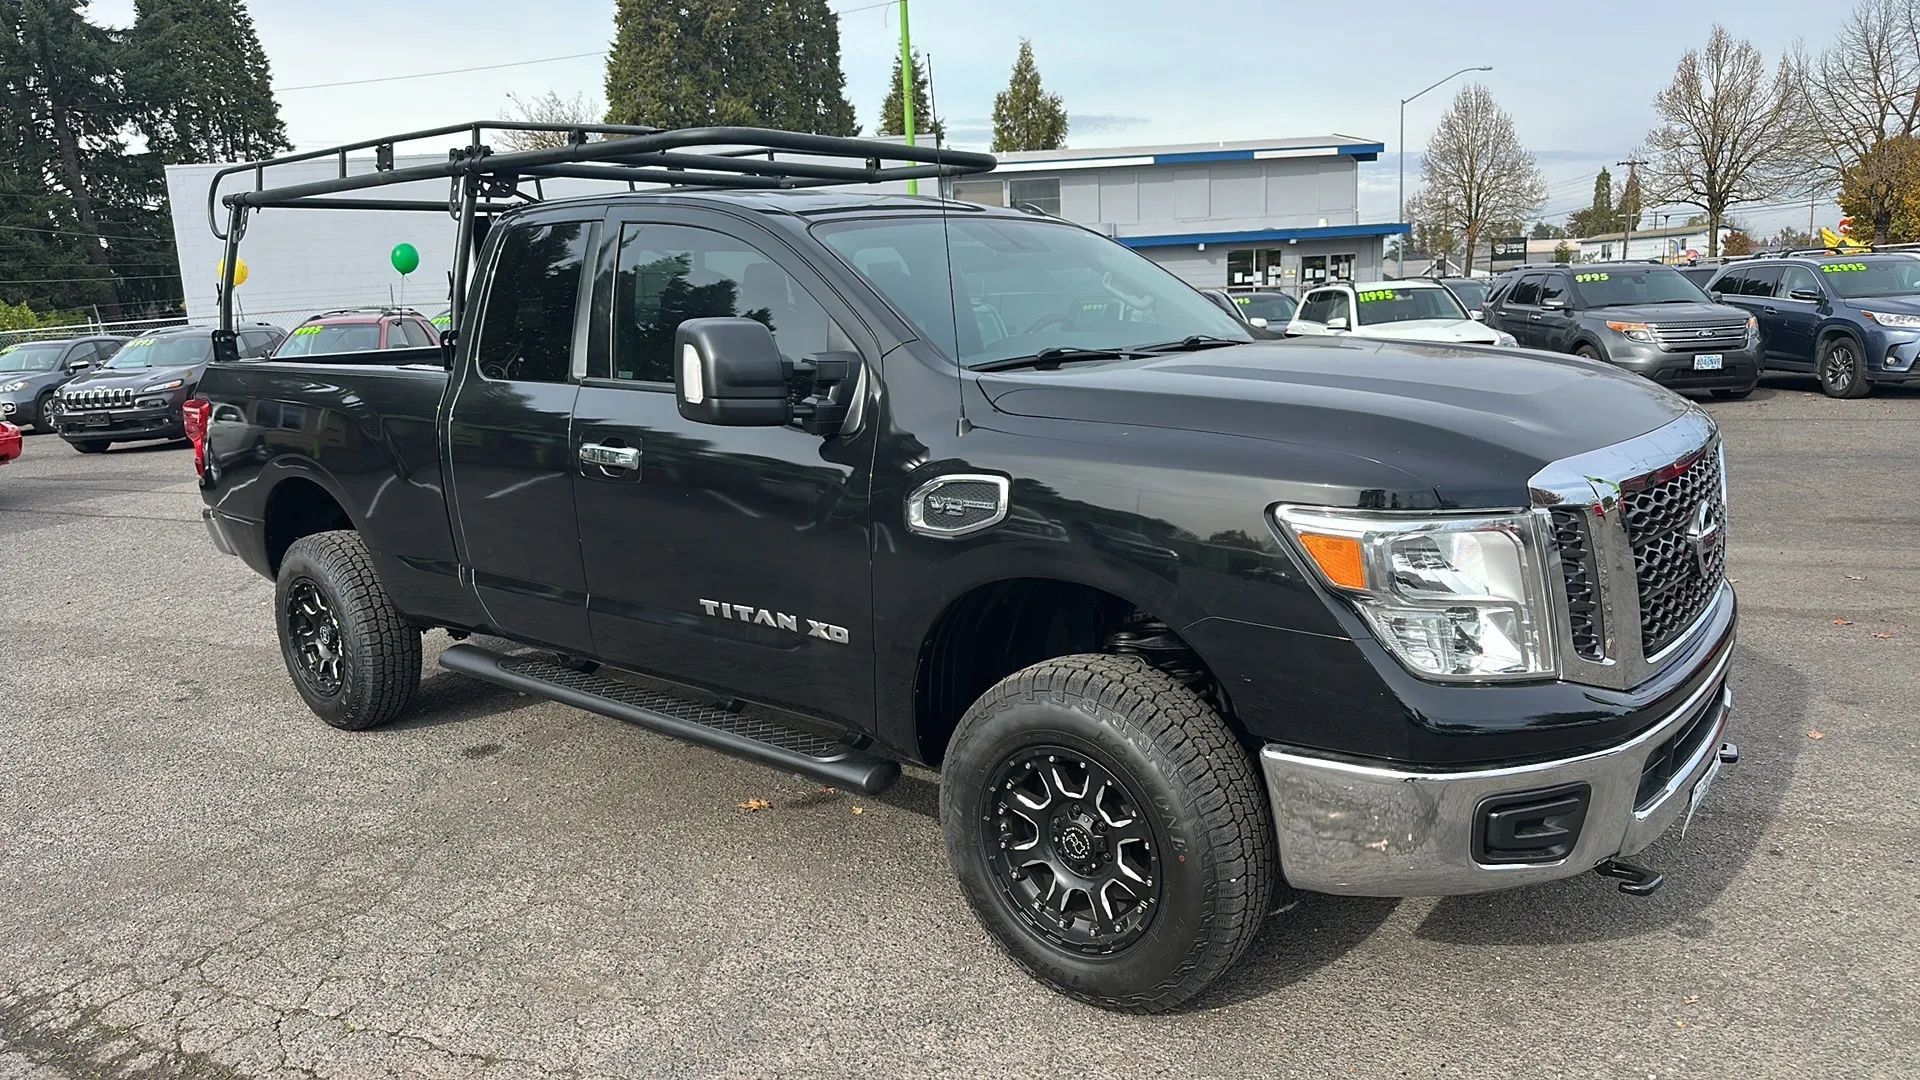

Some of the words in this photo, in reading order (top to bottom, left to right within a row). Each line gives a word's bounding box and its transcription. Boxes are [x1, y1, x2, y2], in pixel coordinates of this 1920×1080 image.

[1821, 263, 1867, 272] 22995
[1575, 273, 1609, 282] 9995
[1359, 290, 1394, 302] 11995
[700, 599, 798, 632] TITAN
[806, 619, 849, 644] XD
